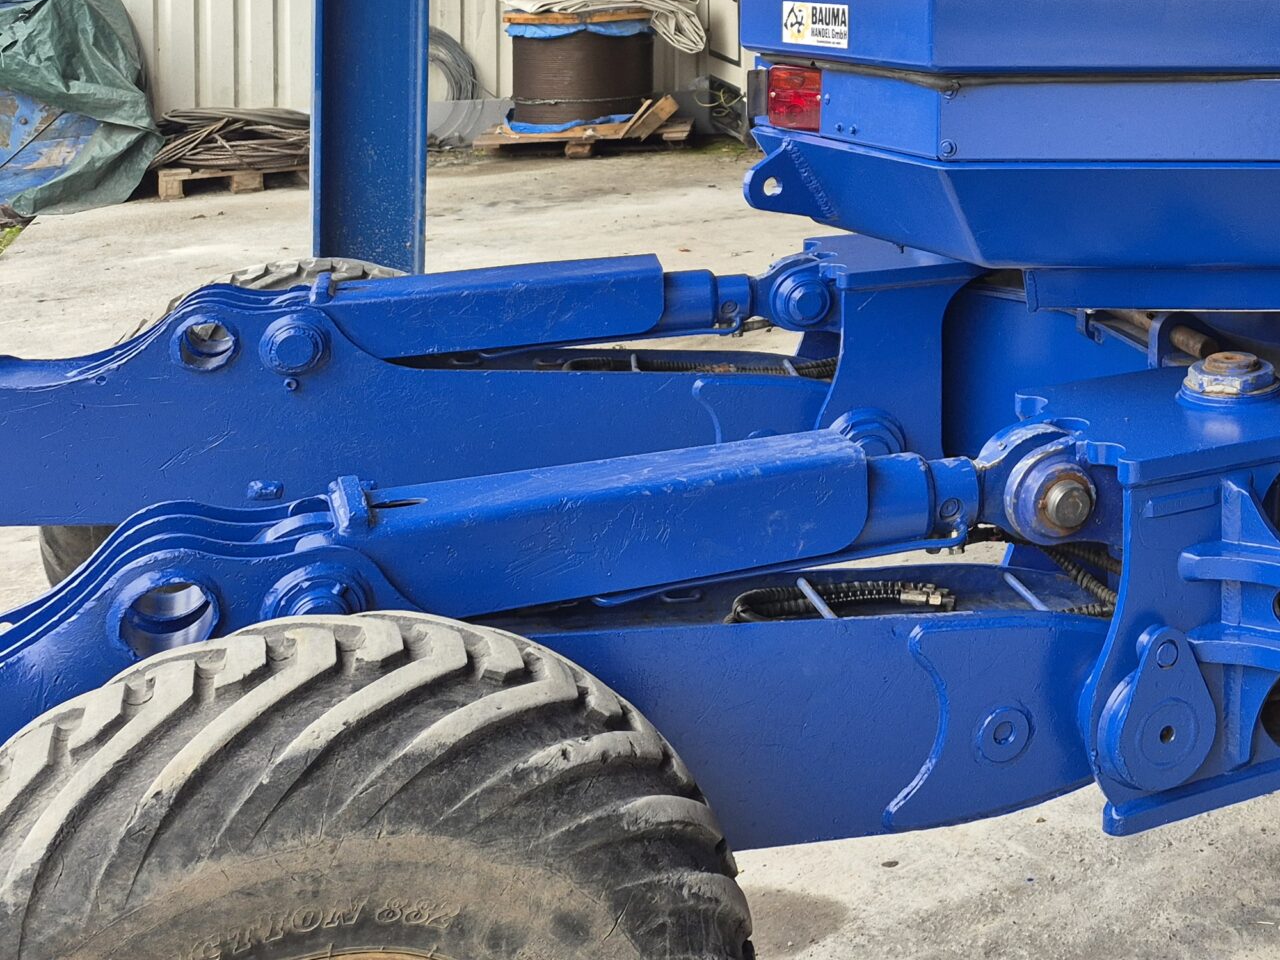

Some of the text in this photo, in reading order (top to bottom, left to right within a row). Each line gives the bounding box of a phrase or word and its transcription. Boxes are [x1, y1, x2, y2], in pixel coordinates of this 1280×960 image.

[811, 6, 847, 27] BAUMA
[811, 27, 848, 40] HANDEL GmbH
[177, 896, 460, 960] CTION 882
